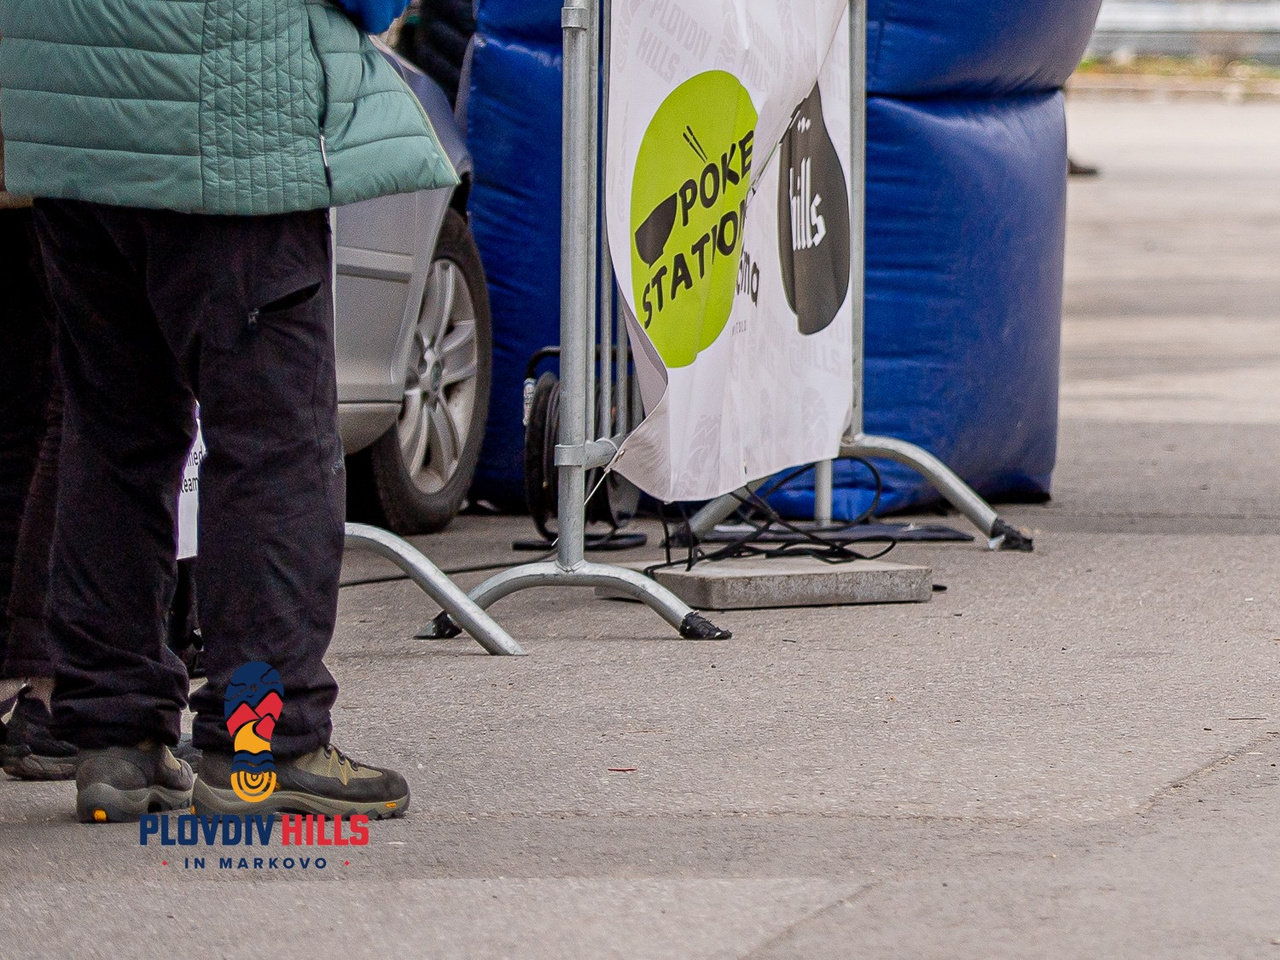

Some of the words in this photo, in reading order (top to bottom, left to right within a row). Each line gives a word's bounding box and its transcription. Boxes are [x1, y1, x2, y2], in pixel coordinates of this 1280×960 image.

[636, 27, 682, 85] HILLS
[681, 130, 755, 227] POKE
[790, 158, 827, 251] hills
